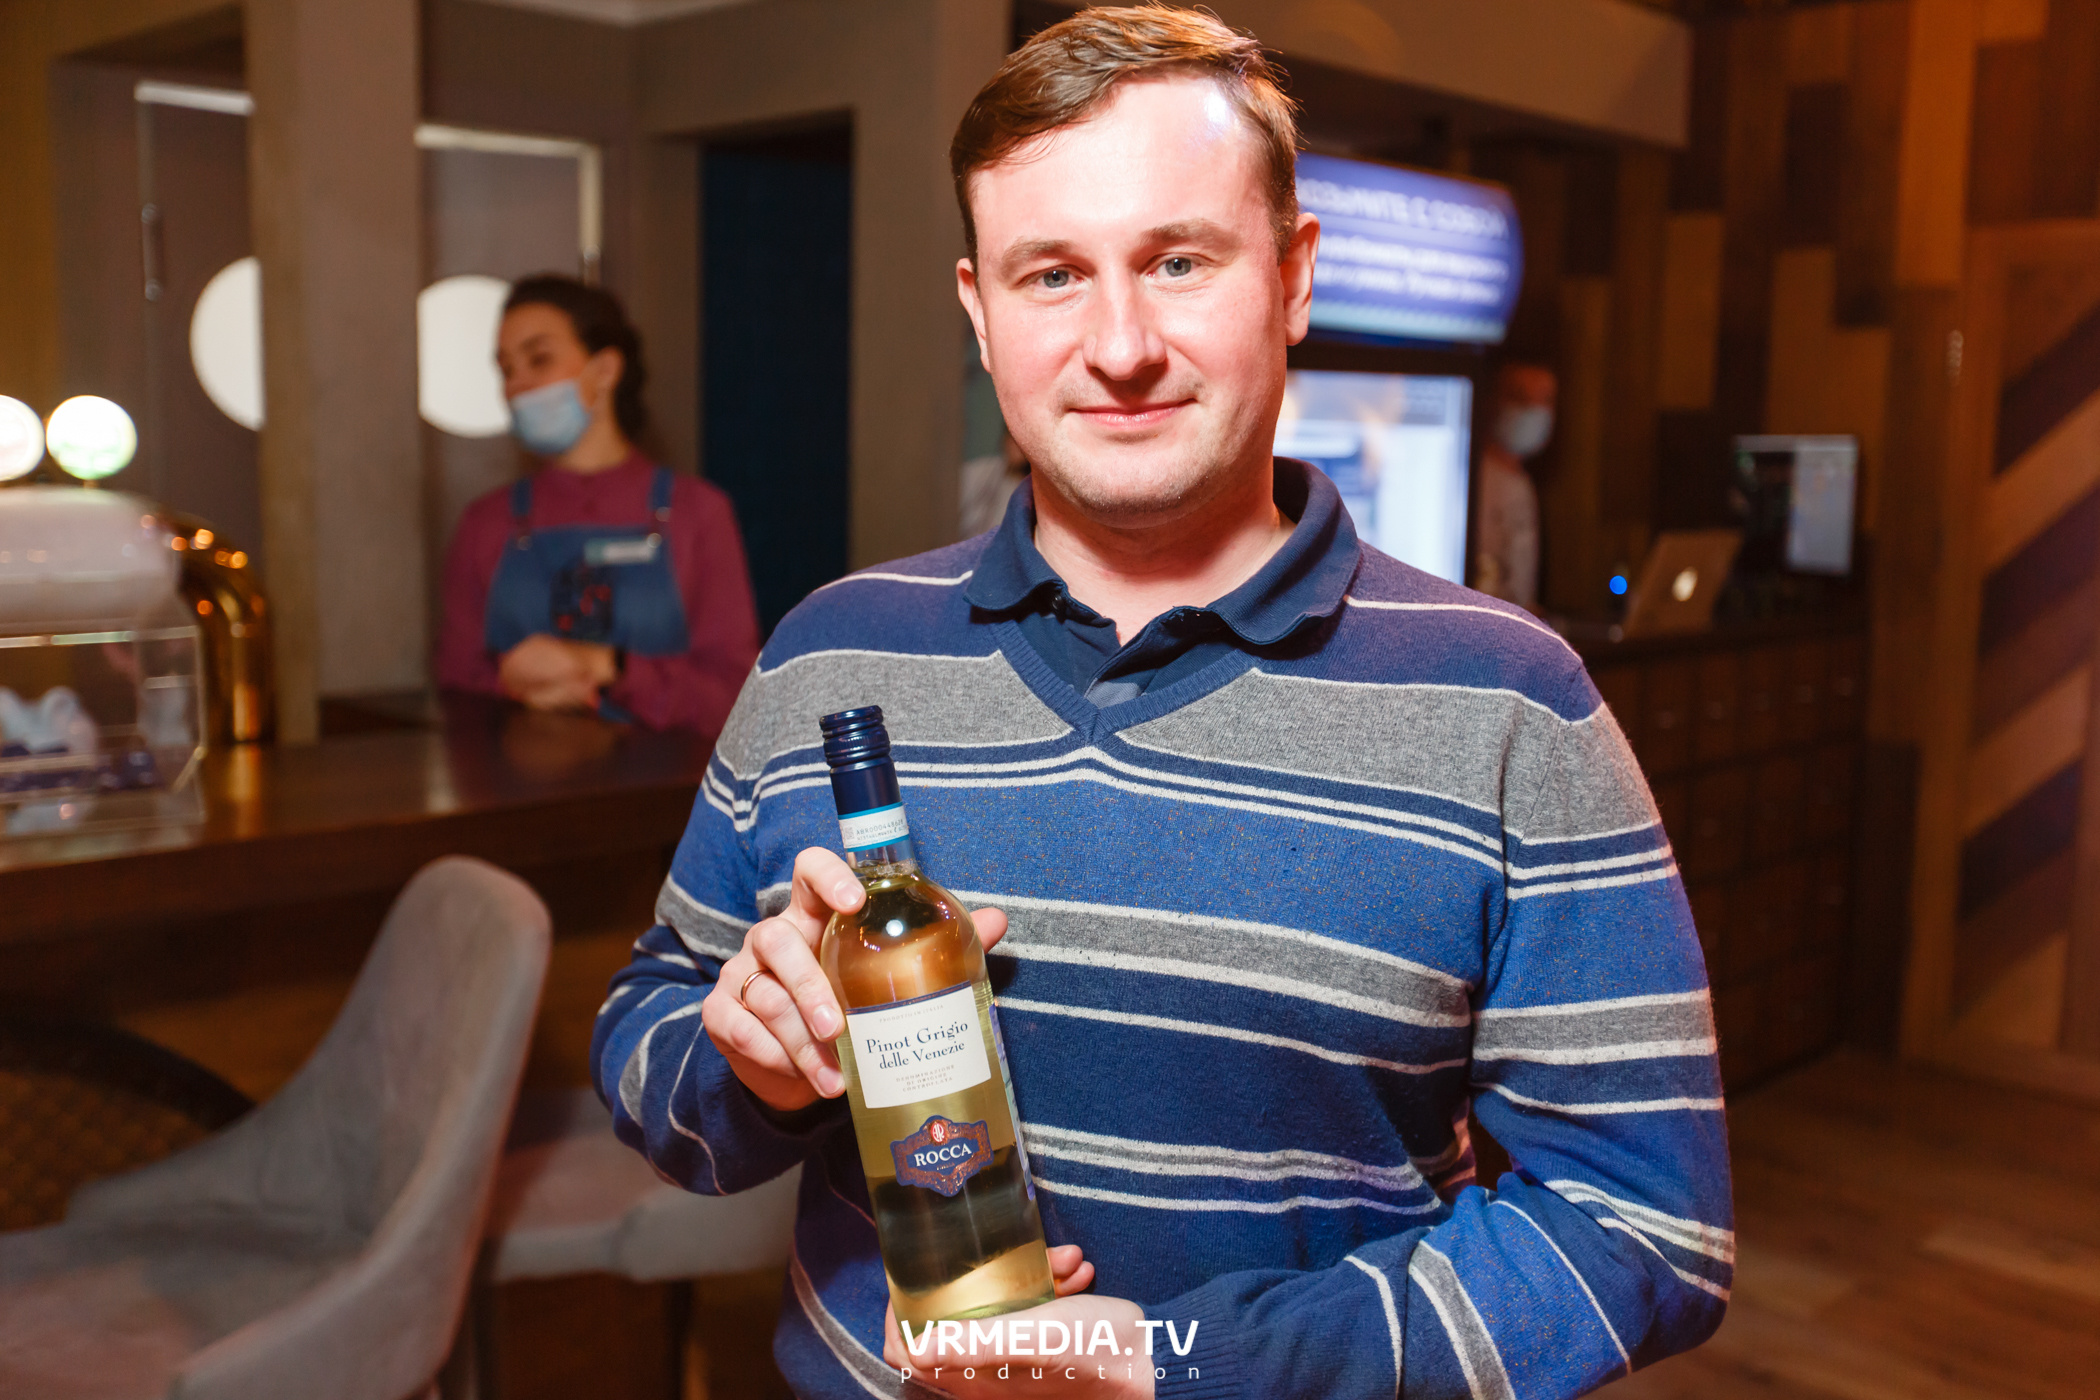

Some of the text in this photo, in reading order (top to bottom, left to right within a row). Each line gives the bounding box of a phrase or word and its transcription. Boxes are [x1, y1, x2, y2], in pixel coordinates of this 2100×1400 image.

[866, 1021, 968, 1054] Pinot Grigio
[880, 1041, 965, 1069] delle Venezie
[914, 1144, 971, 1166] ROCCA
